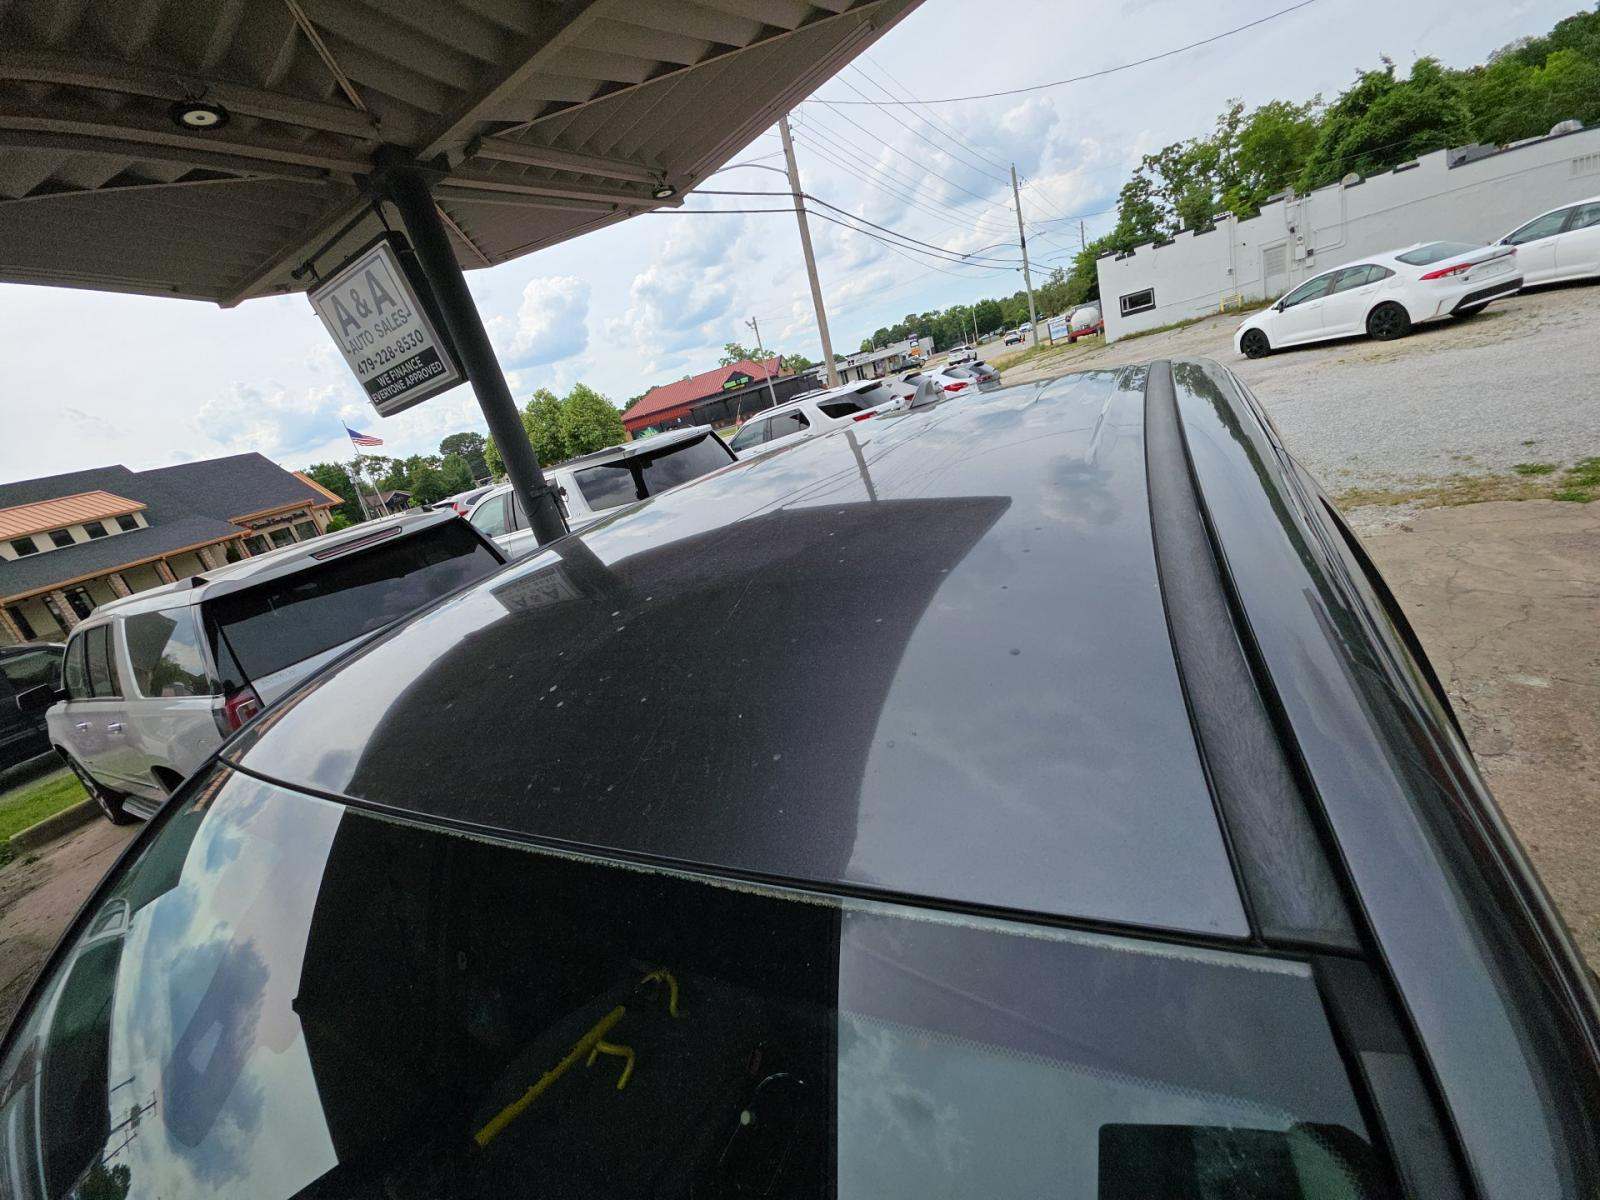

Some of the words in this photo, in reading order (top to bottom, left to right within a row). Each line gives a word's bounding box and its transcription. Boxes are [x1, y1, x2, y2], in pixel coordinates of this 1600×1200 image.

[350, 330, 375, 354] AUTO
[374, 308, 409, 338] SALES
[357, 329, 425, 375] 479-228-8530
[372, 379, 408, 402] EVERYONE
[406, 361, 443, 389] APPROVED
[377, 371, 392, 387] WE
[389, 356, 423, 381] FINANCE
